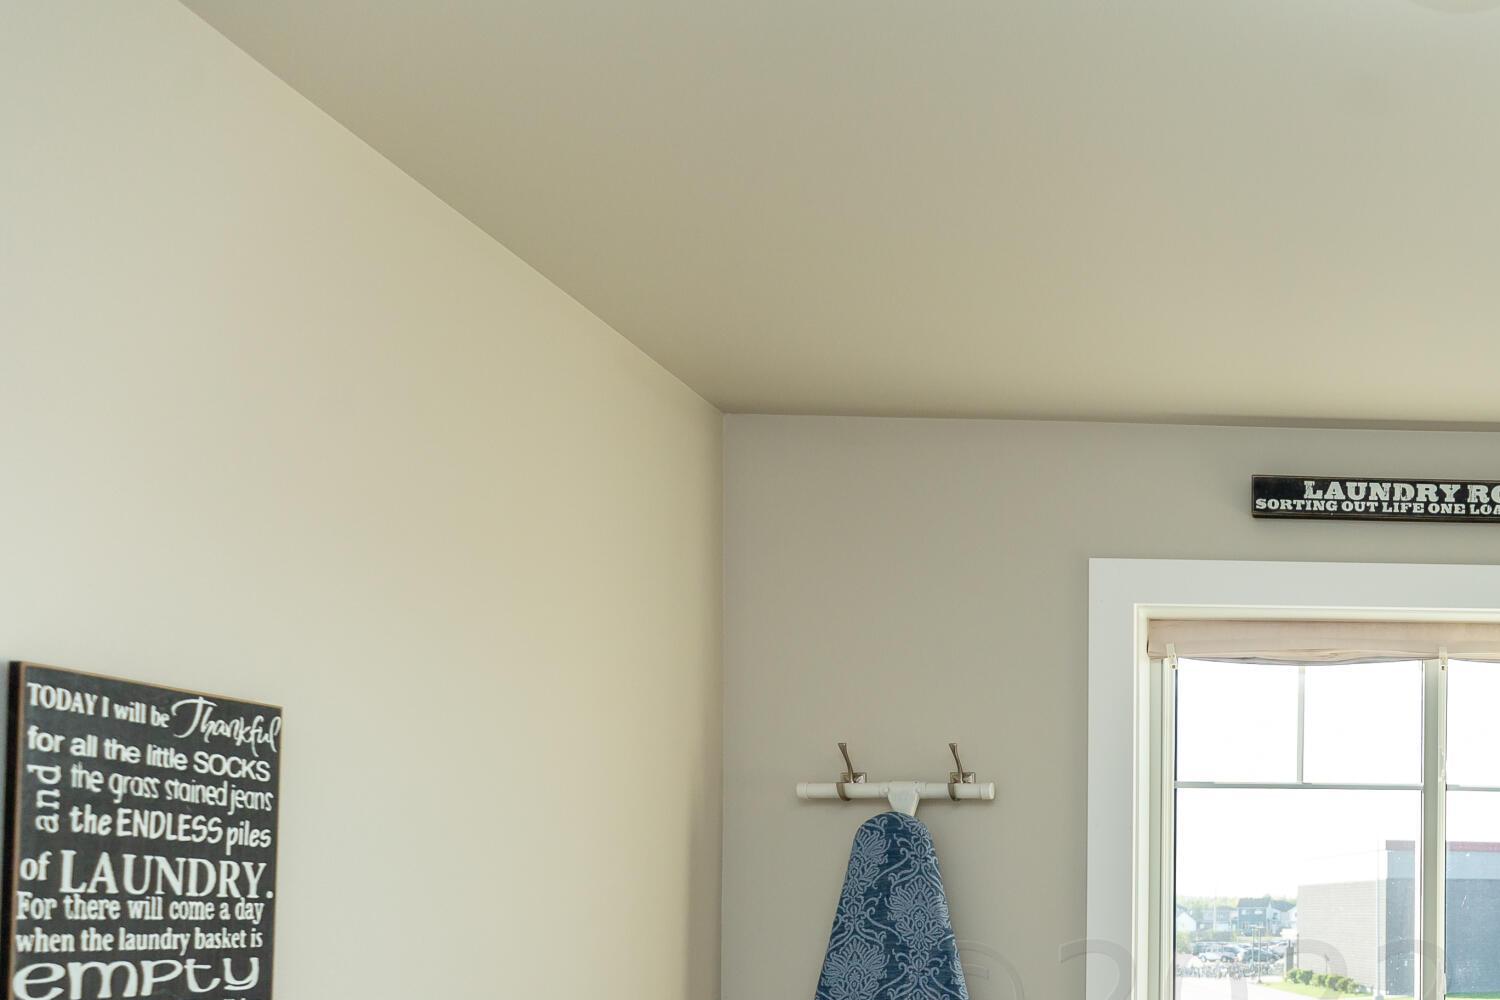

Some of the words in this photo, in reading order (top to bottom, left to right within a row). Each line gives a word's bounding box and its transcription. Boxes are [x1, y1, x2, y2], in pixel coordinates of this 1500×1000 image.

[1255, 498, 1338, 511] SORTING
[1341, 500, 1378, 512] OUT
[1382, 501, 1424, 513] LIFE
[1428, 503, 1465, 515] ONE
[1303, 480, 1461, 503] LAUNDRY
[27, 682, 98, 717] TODAY
[101, 696, 109, 717] I
[114, 702, 146, 724] will
[150, 706, 170, 728] be
[171, 696, 281, 757] Thankful
[27, 725, 65, 752] for
[70, 734, 98, 758] all
[104, 738, 141, 764] the
[146, 744, 188, 771] little
[193, 751, 271, 782] SOCKS
[27, 764, 62, 833] and
[71, 761, 104, 793] the
[109, 773, 160, 803] grass
[165, 779, 228, 807] stained
[228, 785, 274, 815] jeans
[69, 804, 112, 835] the
[117, 808, 223, 843] ENDLESS
[226, 820, 272, 855] piles
[20, 851, 52, 881] of
[59, 850, 274, 899] LAUNDRY.
[16, 891, 58, 920] For
[63, 894, 121, 920] there
[127, 897, 163, 919] will
[169, 901, 215, 920] come
[219, 901, 230, 920] a
[235, 898, 264, 924] day
[16, 927, 75, 952] when
[81, 927, 113, 950] the
[119, 927, 190, 956] laundry
[194, 927, 247, 948] basket
[251, 928, 263, 948] is
